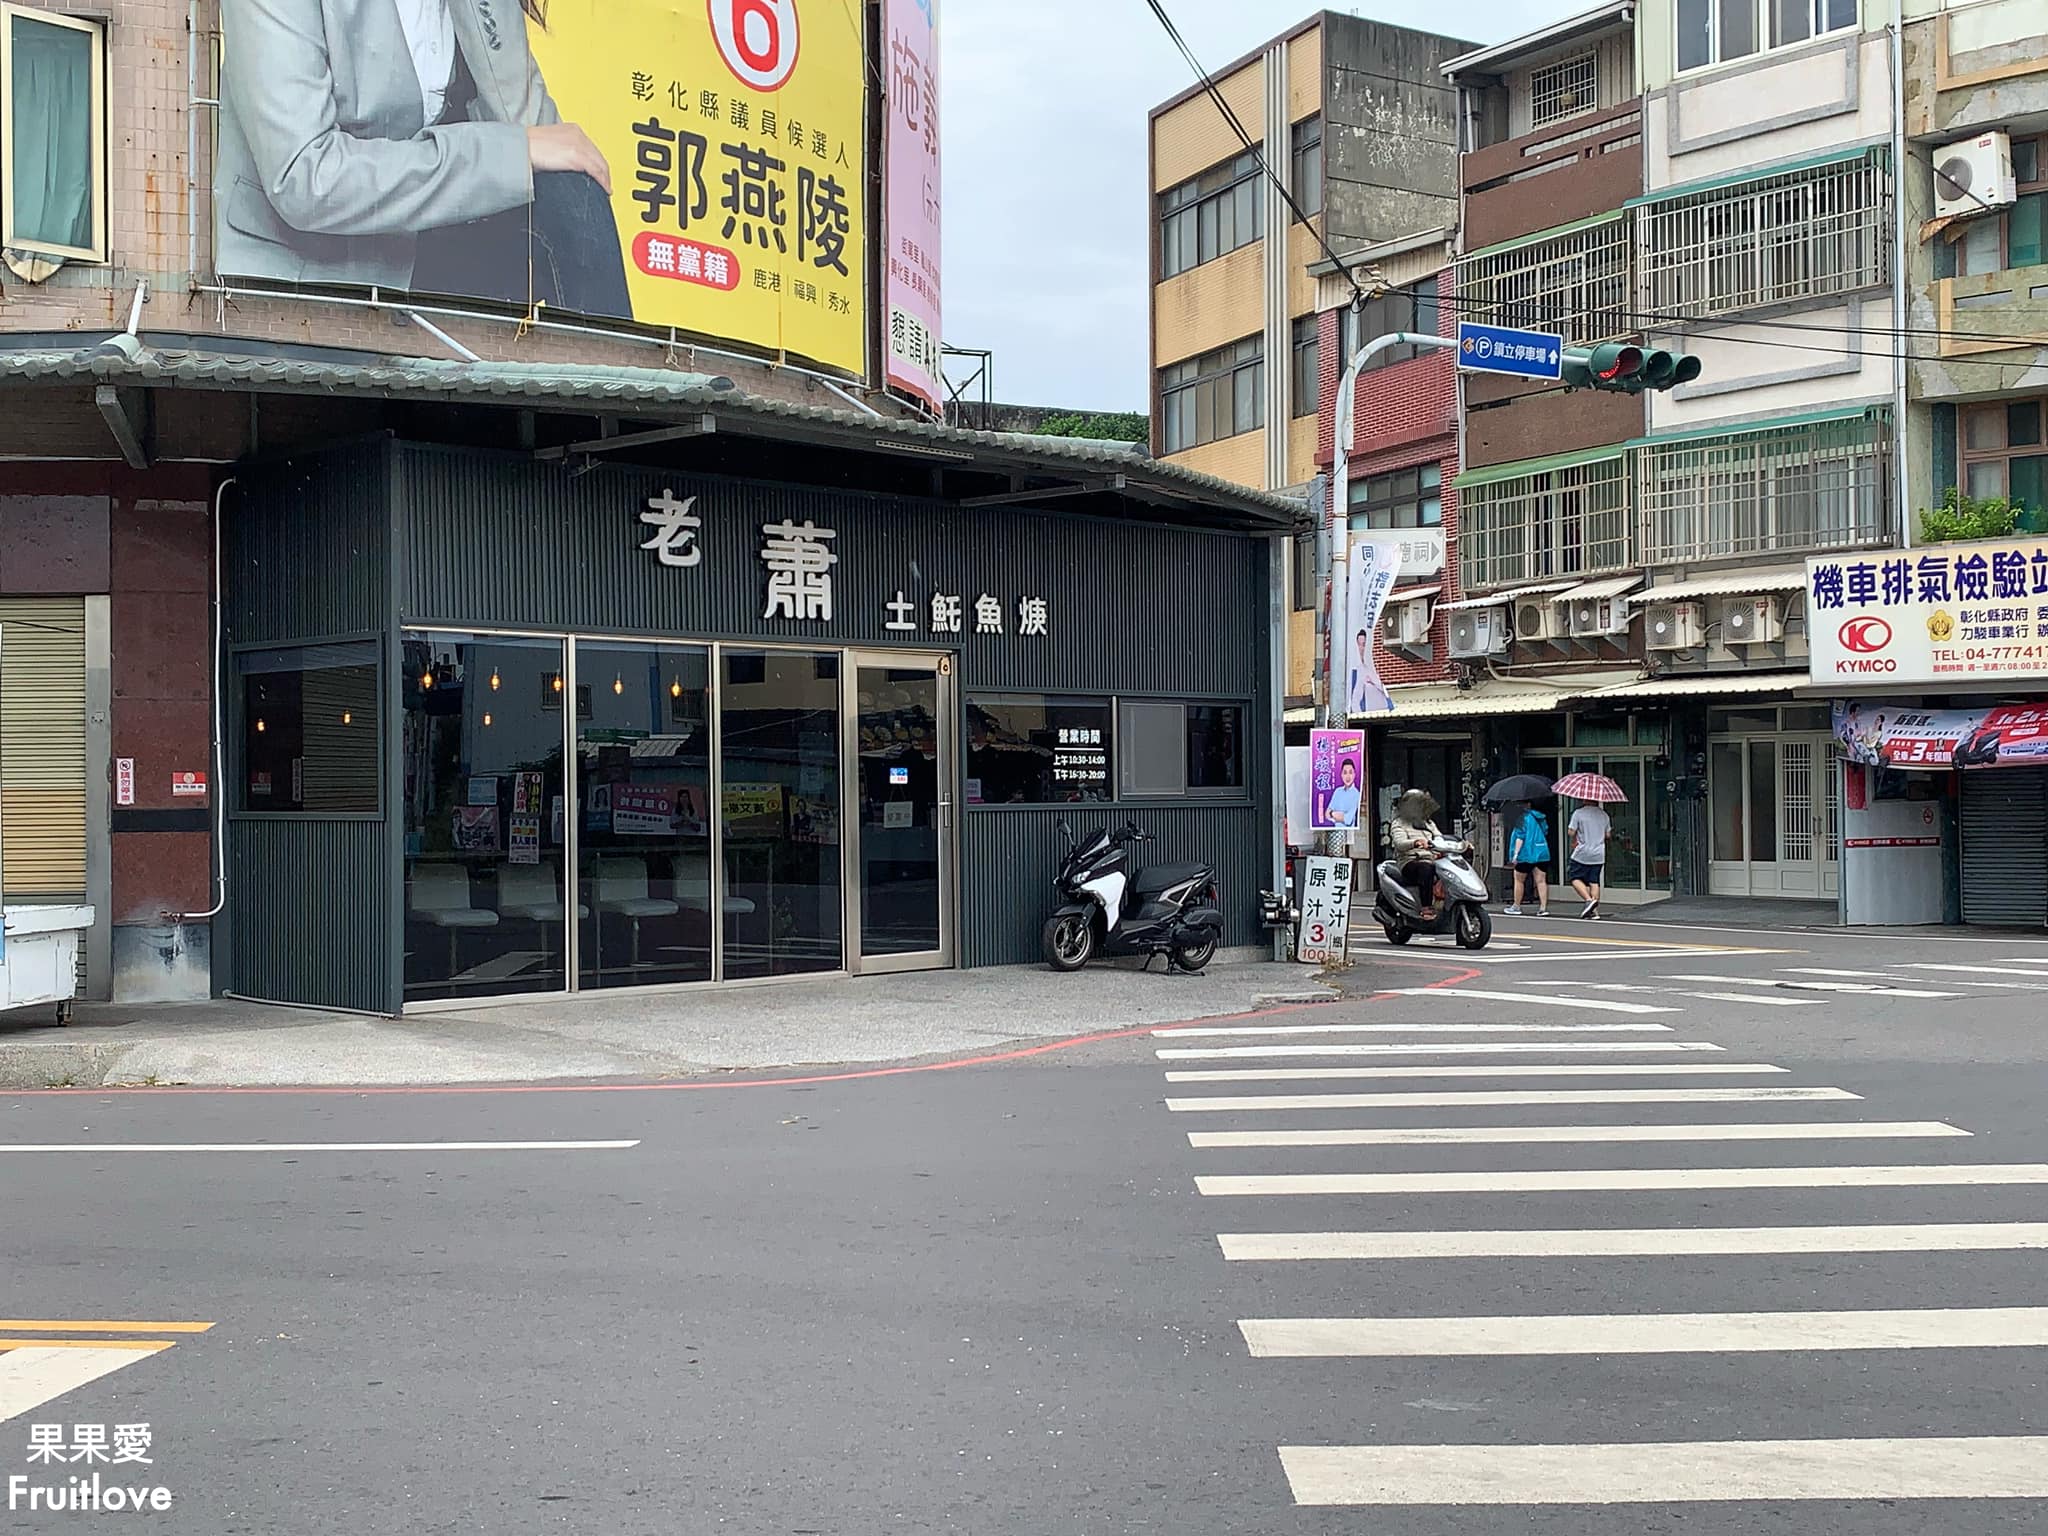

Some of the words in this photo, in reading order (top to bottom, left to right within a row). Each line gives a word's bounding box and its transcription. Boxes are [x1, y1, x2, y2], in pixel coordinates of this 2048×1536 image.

[732, 0, 779, 71] 6
[631, 71, 849, 169] 彰化縣議員候選人
[631, 117, 849, 277] 郭燕陵
[648, 239, 728, 285] 無黨籍
[753, 269, 781, 293] 鹿港
[794, 279, 816, 304] 福興
[828, 292, 850, 314] 秀水
[1493, 341, 1546, 364] 鎮立停車場
[885, 590, 1047, 636] 土魠魚焿
[1960, 607, 2029, 623] 彰化縣政府
[1961, 624, 2029, 640] 力駿車業行
[1836, 659, 1897, 673] KYMCO
[1058, 728, 1100, 744] 營業時間
[1307, 868, 1327, 917] 原汁
[1328, 862, 1350, 928] 椰子汁
[1310, 924, 1325, 943] 3
